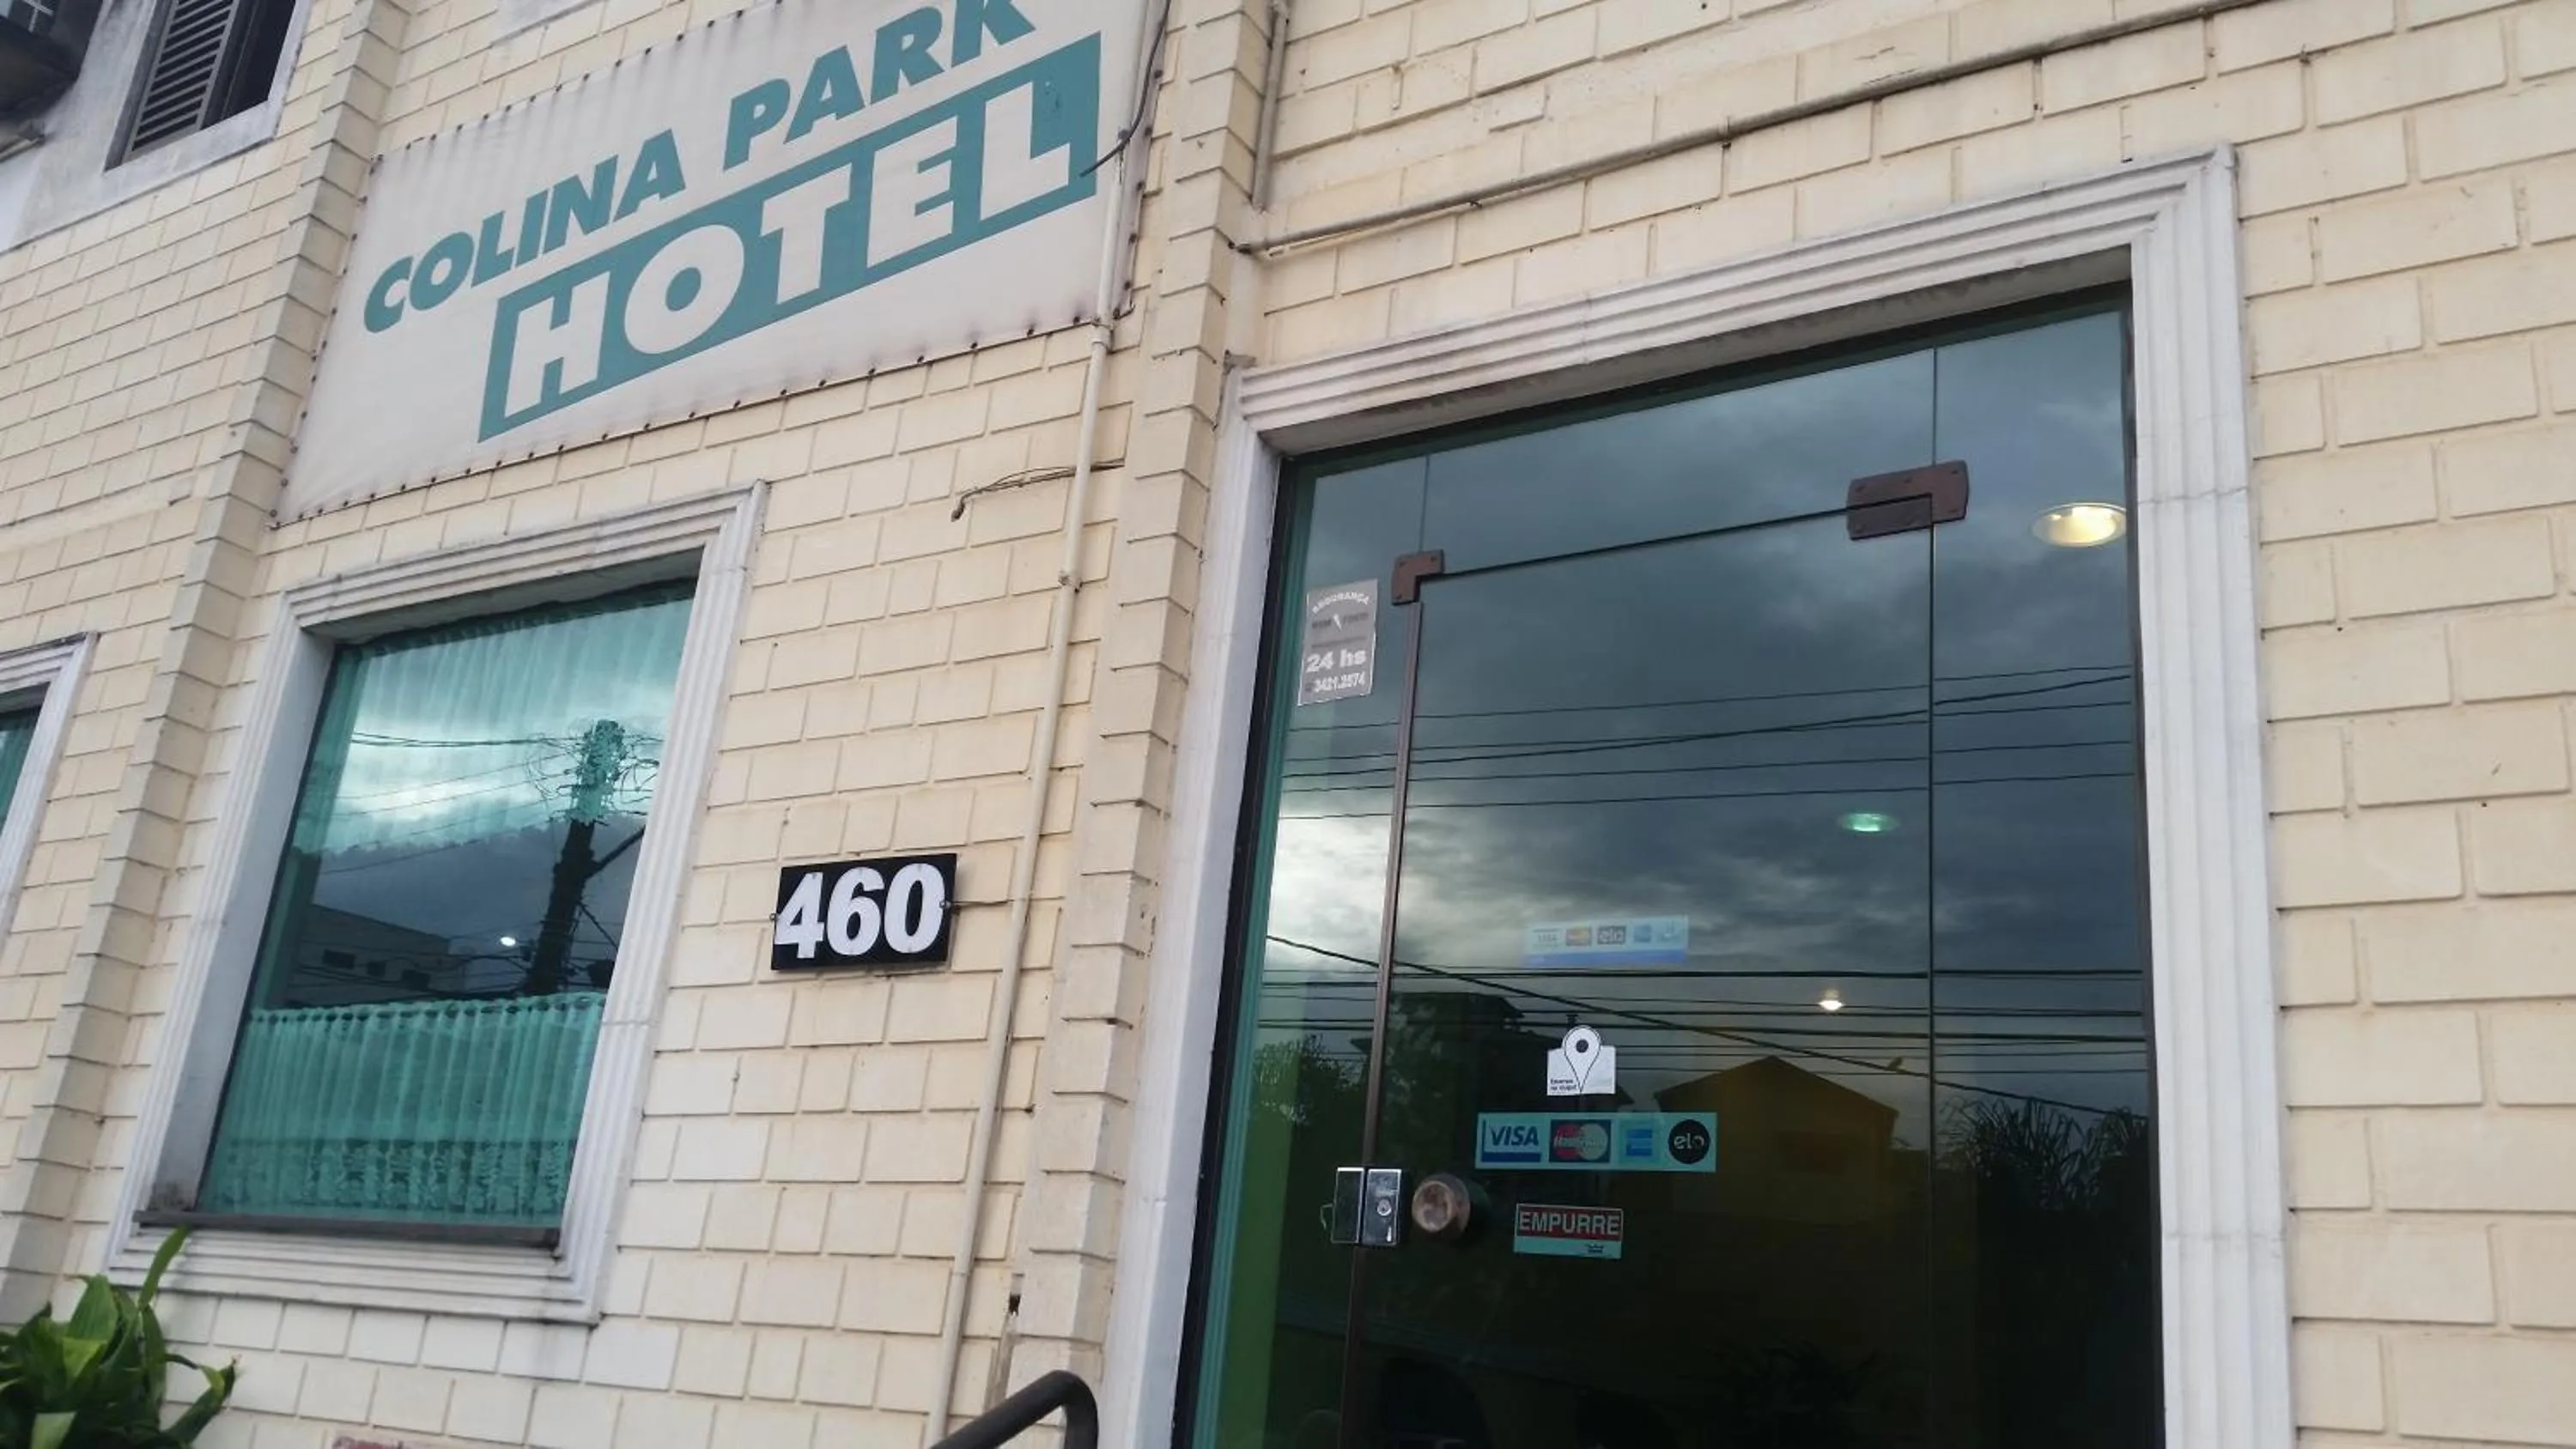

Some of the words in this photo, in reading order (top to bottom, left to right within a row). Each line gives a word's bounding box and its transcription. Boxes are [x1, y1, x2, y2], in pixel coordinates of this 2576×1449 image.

[364, 128, 686, 333] COLINA
[723, 0, 1036, 171] PARK
[505, 82, 1070, 418] HOTEL
[1306, 652, 1334, 672] 24
[1340, 649, 1367, 668] hs
[775, 863, 945, 959] 460
[1491, 1125, 1539, 1147] VISA
[1674, 1132, 1705, 1149] elo
[1519, 1211, 1620, 1235] EMPURRE
